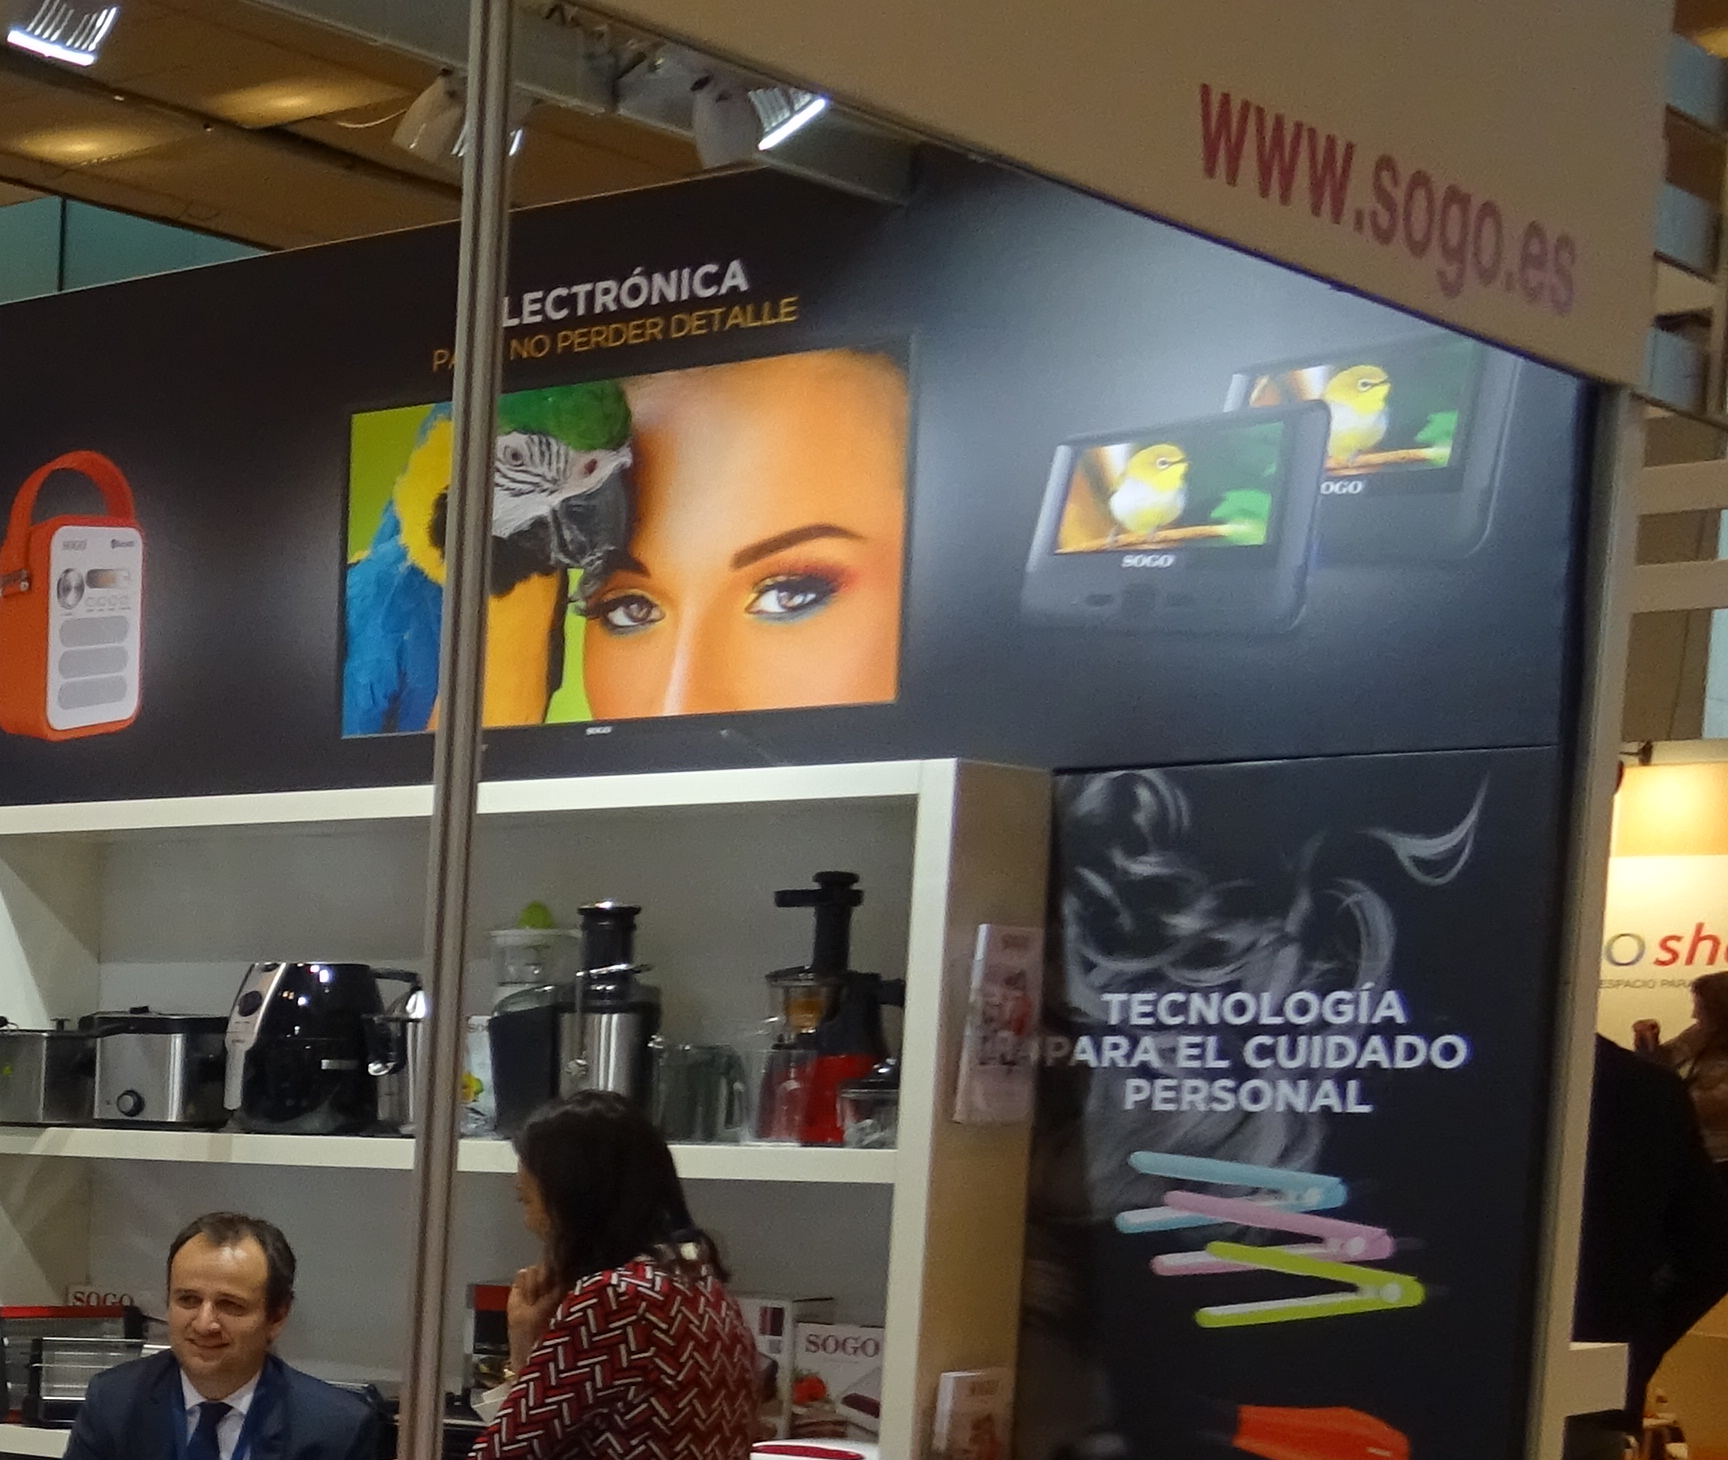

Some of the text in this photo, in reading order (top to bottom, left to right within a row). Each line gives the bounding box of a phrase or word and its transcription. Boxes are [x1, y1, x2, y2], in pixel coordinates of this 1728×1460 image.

[1199, 82, 1577, 317] www.sogo.es
[501, 258, 749, 328] LECTRÓNICA
[510, 297, 799, 360] NO PERDER DETALLE
[1319, 479, 1364, 495] OGO
[1121, 553, 1175, 569] SOGO
[1100, 982, 1407, 1027] TECNOLOGÍA
[1047, 1034, 1471, 1071] PARA EL CUIDADO
[1123, 1078, 1373, 1114] PERSONAL
[72, 1290, 136, 1308] SOGO
[804, 1332, 880, 1359] SOGO
